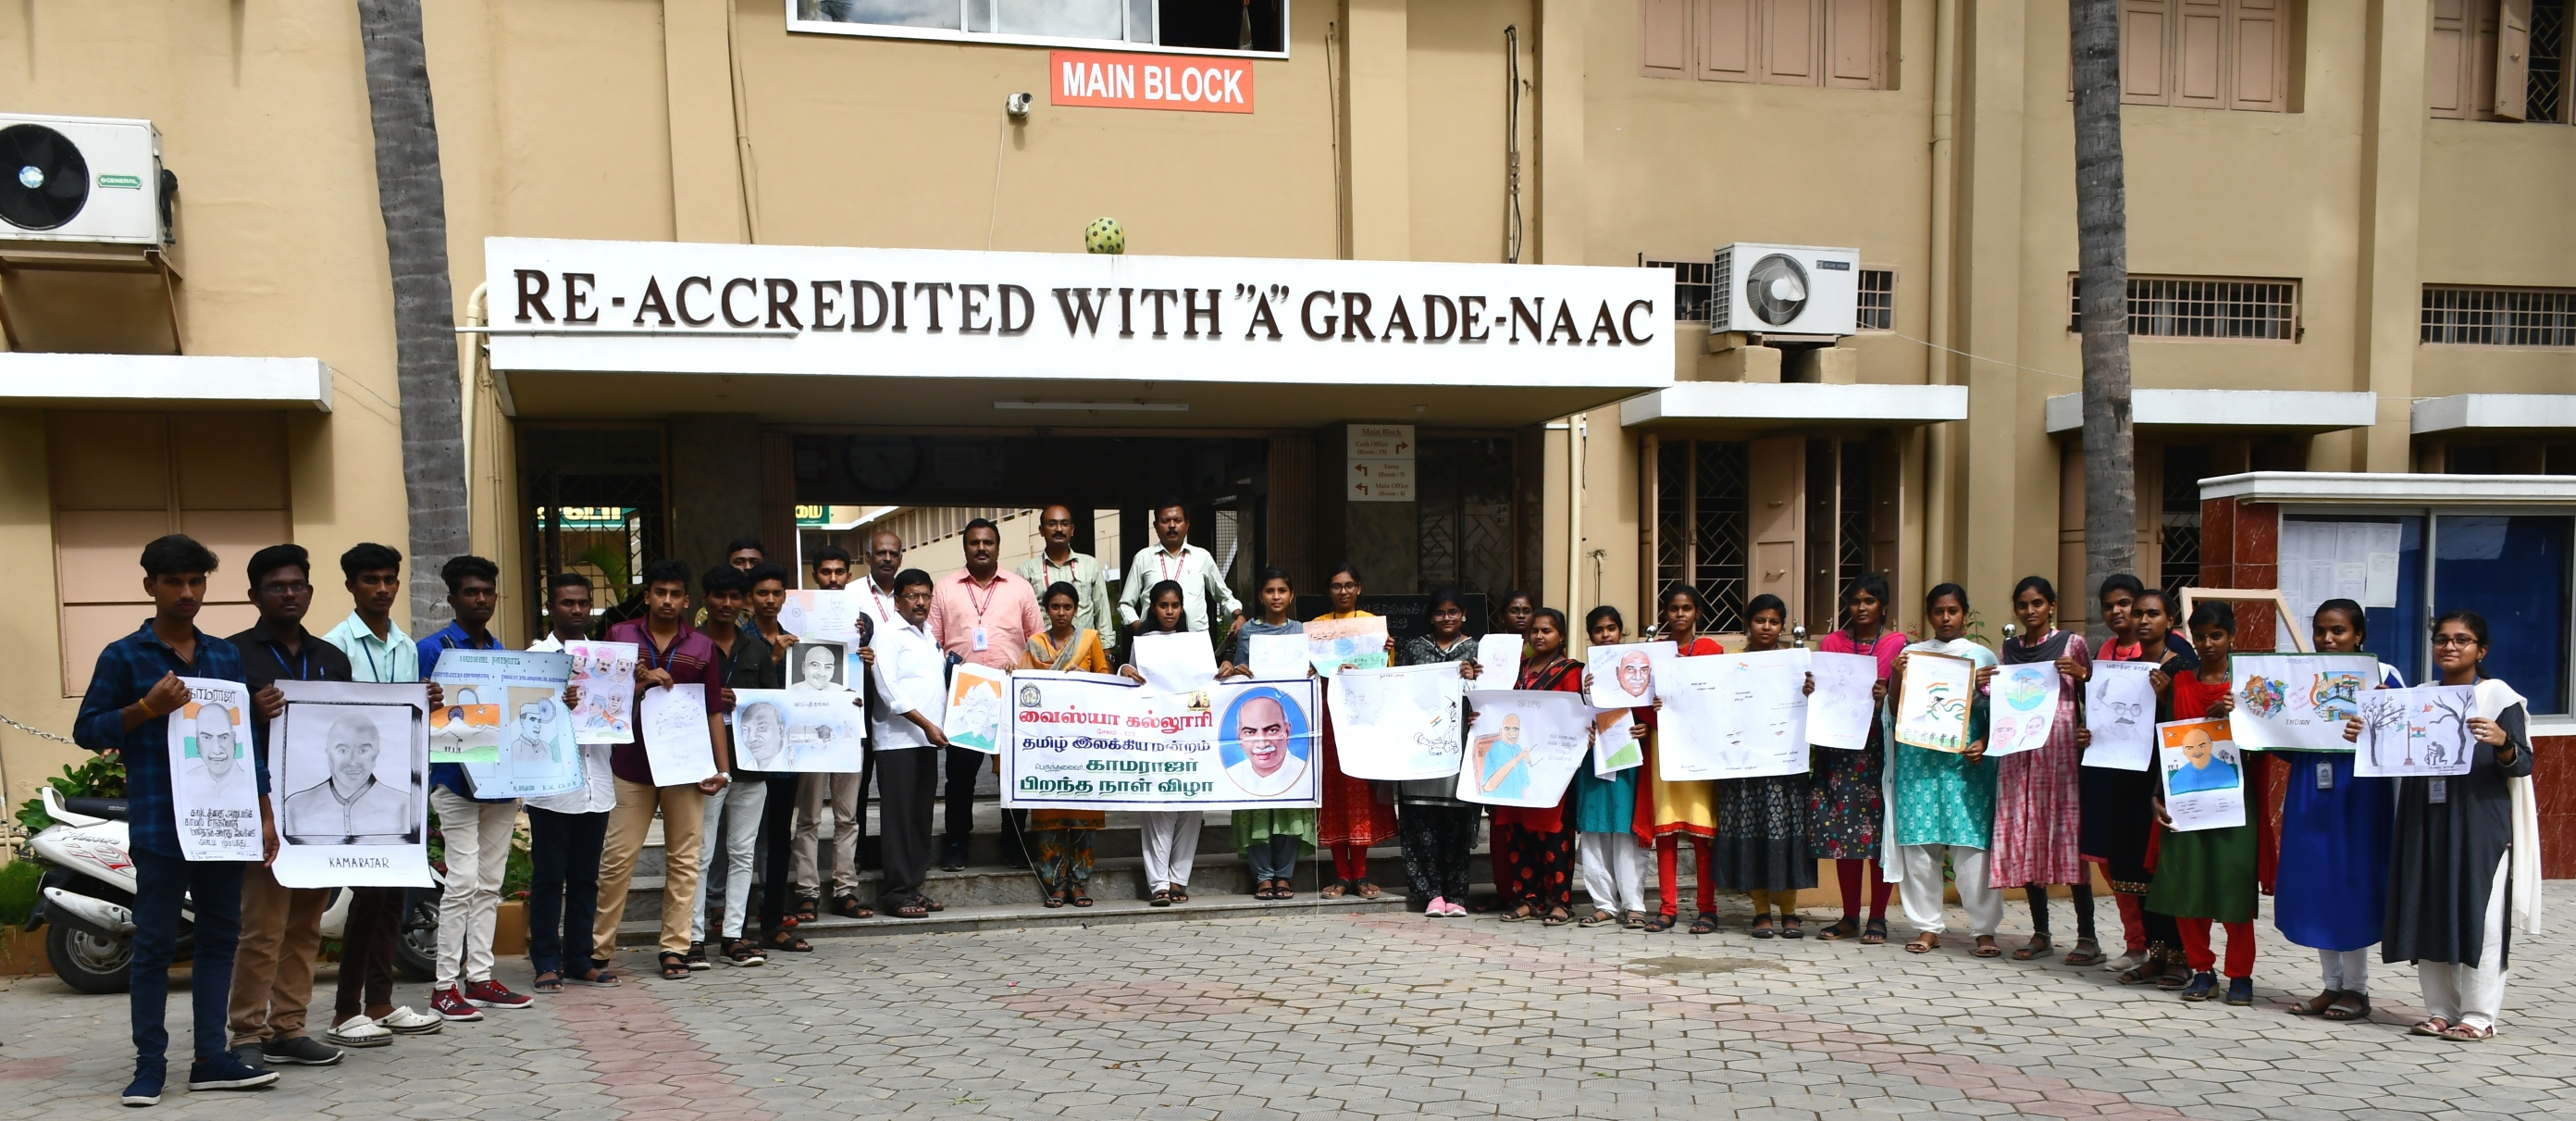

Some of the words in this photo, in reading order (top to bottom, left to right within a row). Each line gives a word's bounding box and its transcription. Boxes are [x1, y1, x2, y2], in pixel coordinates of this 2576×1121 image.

[1063, 62, 1134, 98] MAIN
[1145, 66, 1244, 103] BLOCK
[1052, 287, 1222, 336] WITH
[1301, 290, 1653, 343] GRADE-NAAC
[1019, 704, 1121, 726] வைஸ்யா
[1126, 709, 1213, 733] கல்லூரி
[1096, 728, 1117, 736] சேலம்
[1022, 735, 1068, 753] தமிழ்
[1072, 735, 1148, 752] இலக்கிய
[1152, 740, 1210, 754] மன்றம்
[1086, 758, 1198, 774] காமராஜர்
[1020, 776, 1094, 796] பிறந்த
[1098, 778, 1153, 797] நாள்
[1158, 778, 1214, 797] விழா
[329, 857, 390, 868] KAMARAJAR
